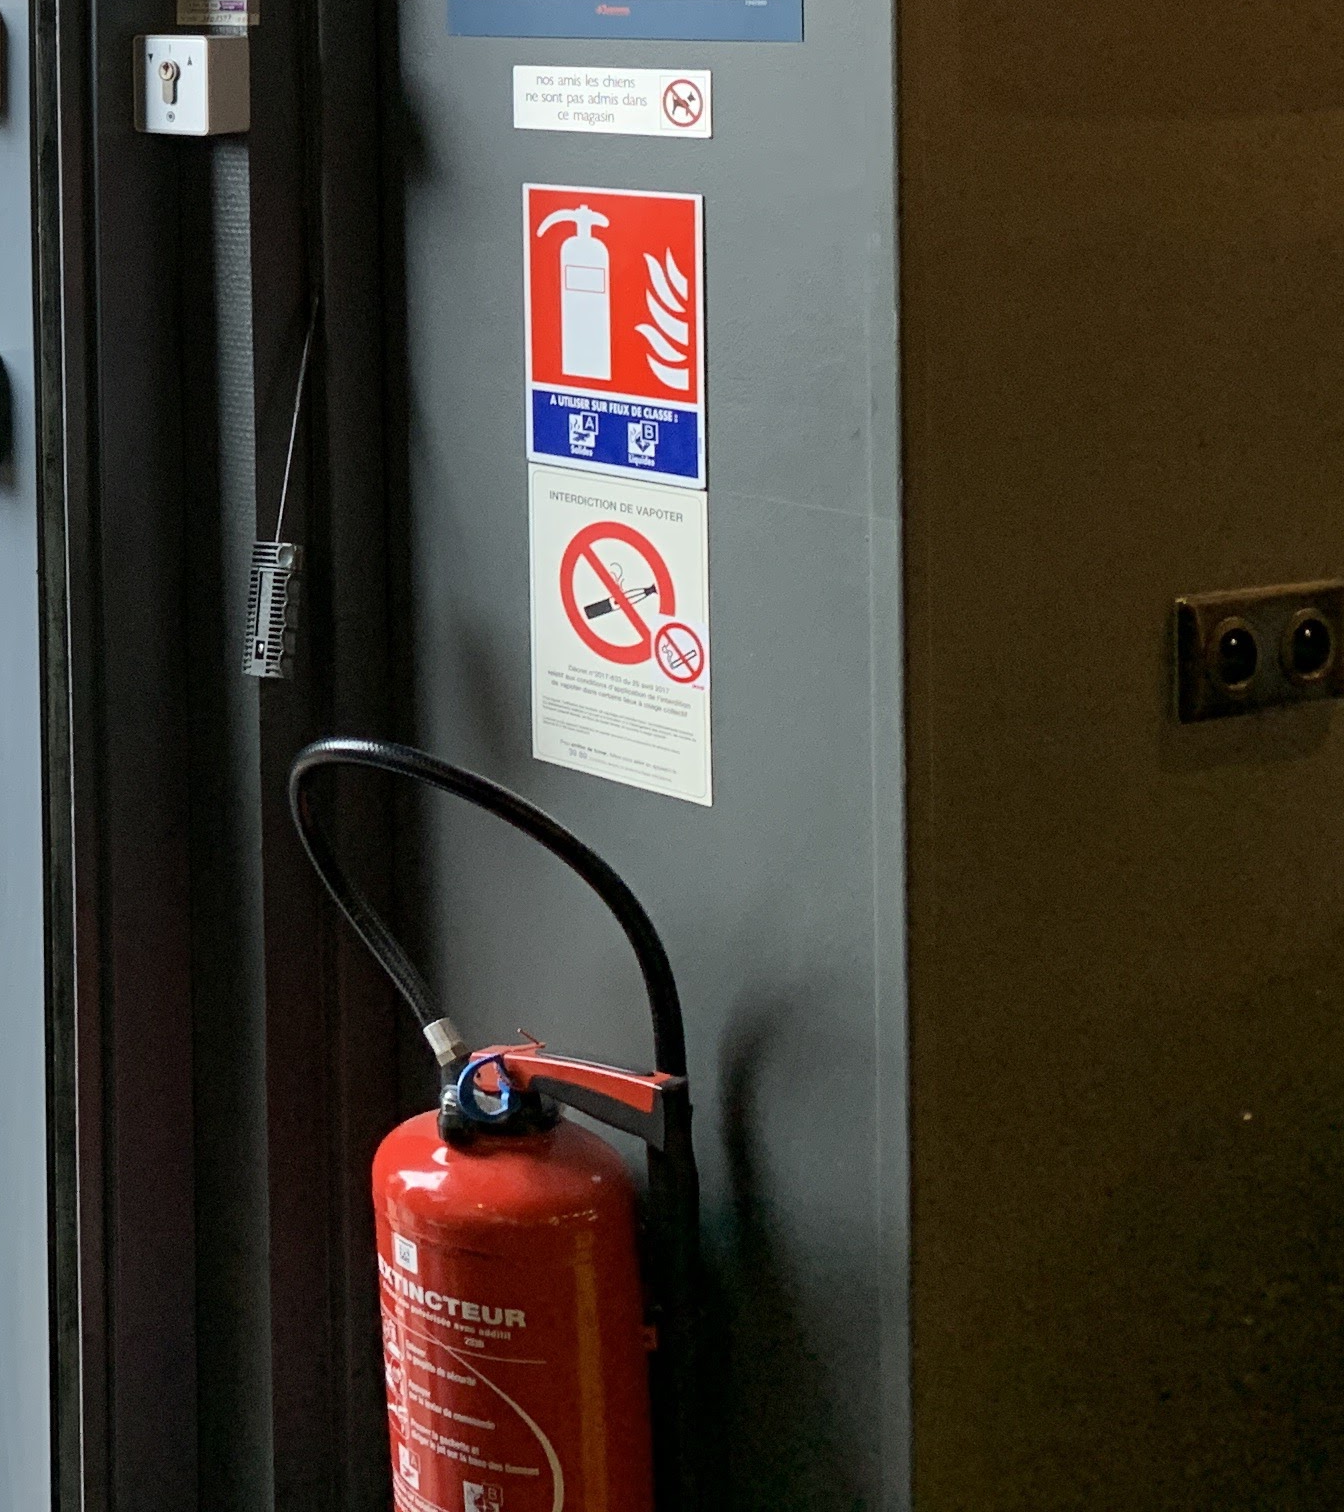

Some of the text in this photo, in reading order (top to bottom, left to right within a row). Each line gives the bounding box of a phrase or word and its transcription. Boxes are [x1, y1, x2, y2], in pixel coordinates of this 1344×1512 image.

[536, 74, 636, 88] nos amis les chiens
[526, 92, 647, 107] ne sont pas admis dans
[557, 111, 615, 125] ce magasin
[550, 396, 557, 405] A
[558, 397, 591, 410] UTILISER
[592, 402, 608, 413] SUR
[609, 404, 629, 415] FEUX
[631, 407, 642, 417] DE
[644, 408, 673, 421] CLASSE
[584, 416, 654, 438] A B
[620, 503, 633, 513] DE
[636, 506, 683, 522] VAPOTER
